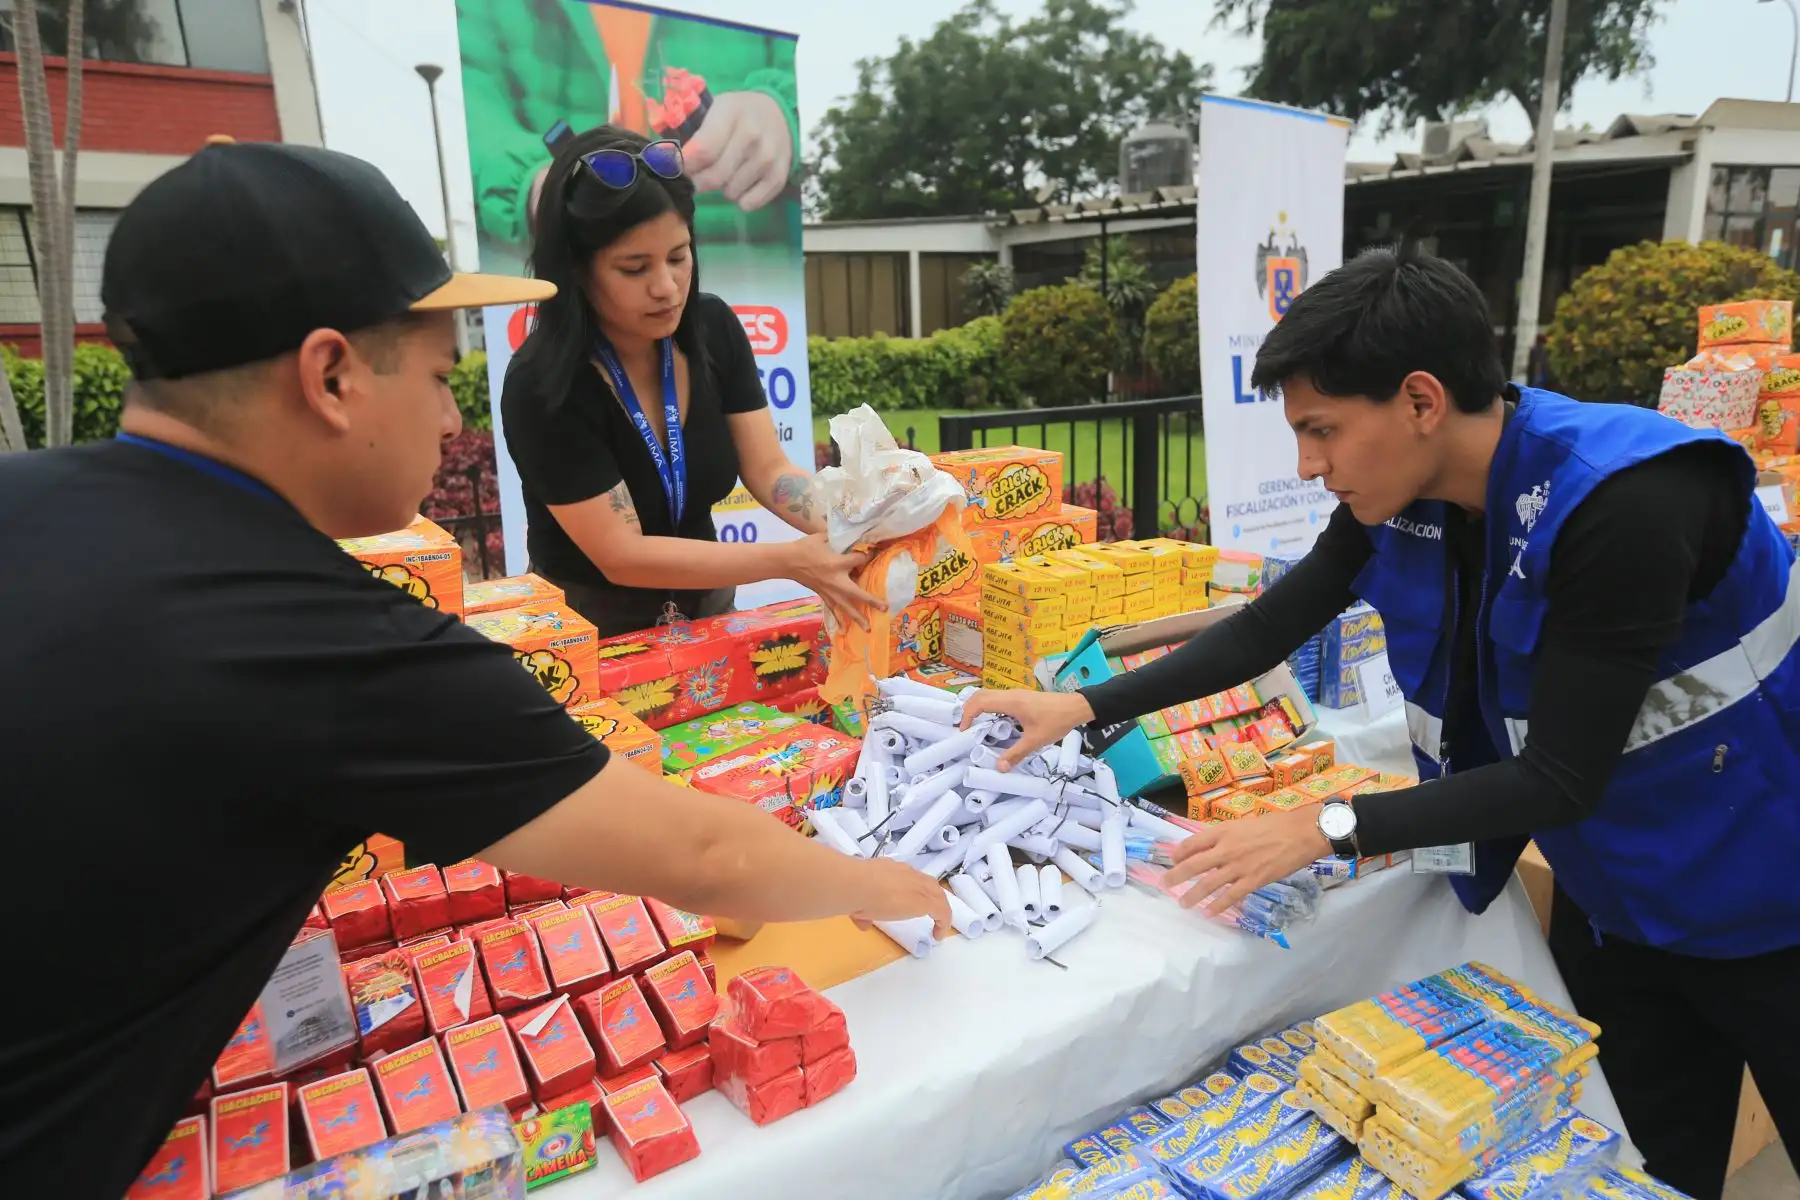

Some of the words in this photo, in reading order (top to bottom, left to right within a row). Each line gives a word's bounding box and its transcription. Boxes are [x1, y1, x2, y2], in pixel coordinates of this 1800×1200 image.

[645, 434, 663, 468] LIMA
[668, 429, 679, 463] LIMA
[991, 467, 1031, 498] CRICK
[995, 477, 1043, 514] CRACK
[1259, 478, 1306, 494] GERENCIA
[1227, 495, 1298, 518] FISCALIZACIÓN
[1024, 526, 1065, 557] CRICK
[920, 551, 968, 592] CRACK
